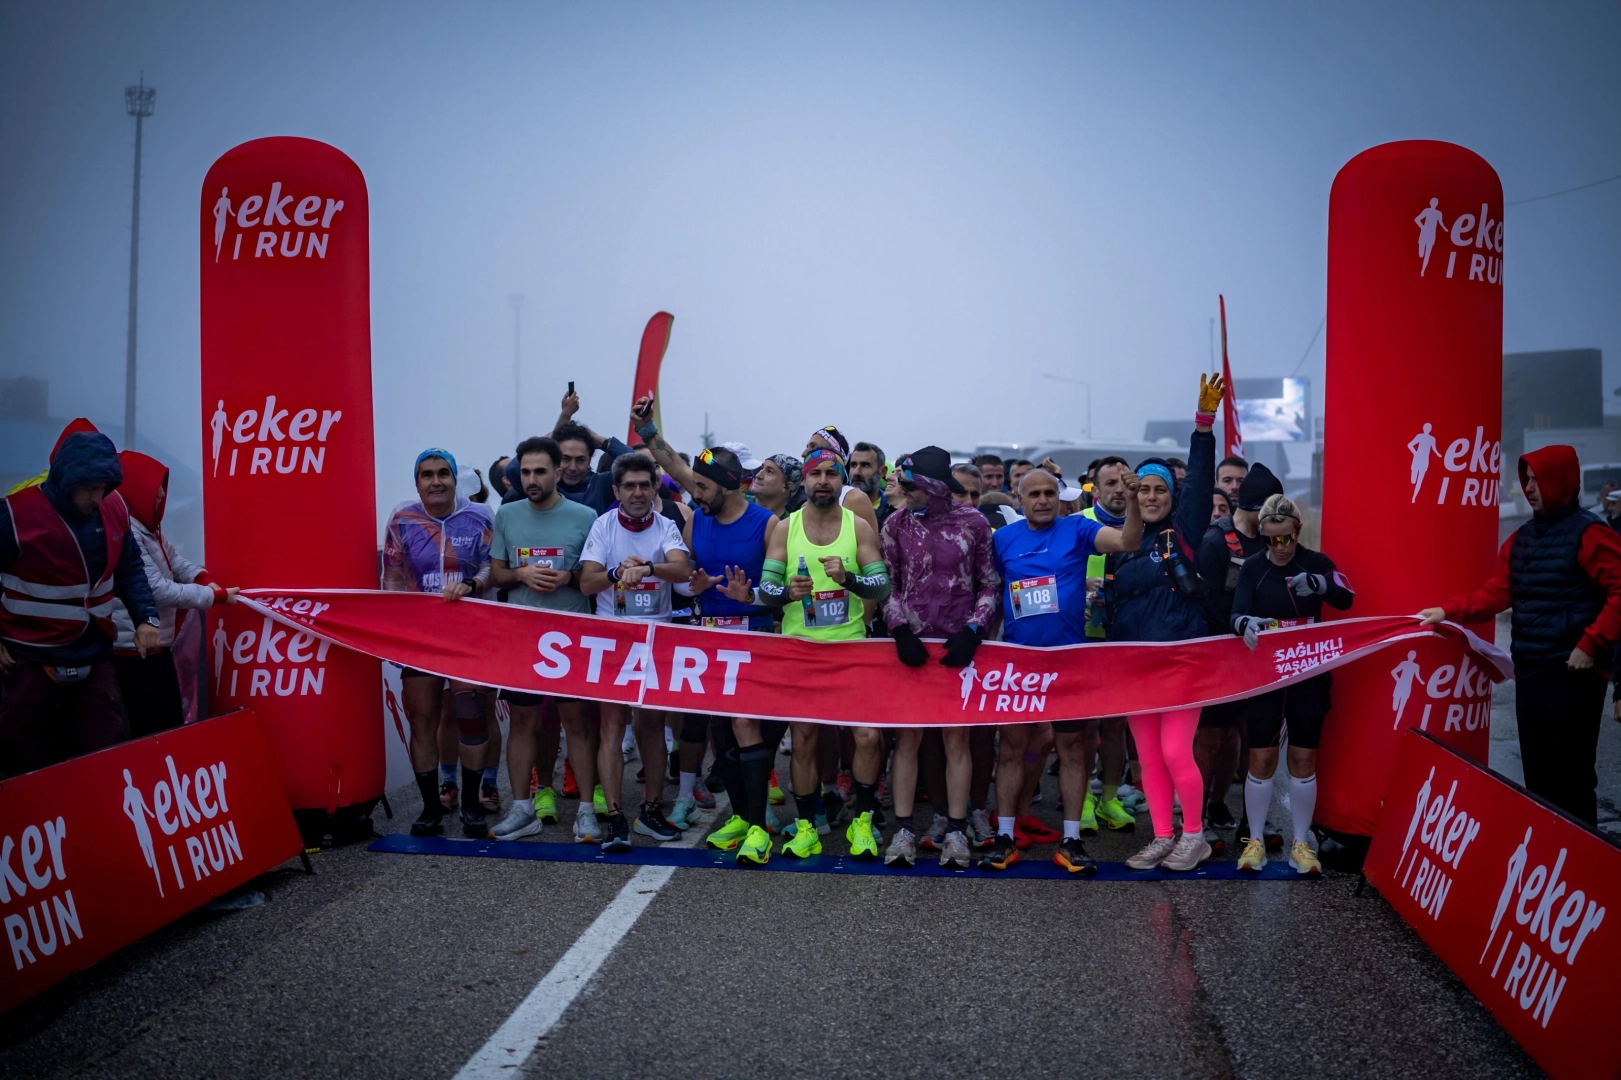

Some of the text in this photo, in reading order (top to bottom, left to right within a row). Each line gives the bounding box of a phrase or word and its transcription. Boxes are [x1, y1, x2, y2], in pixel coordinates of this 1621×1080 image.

[237, 181, 344, 228] eker
[233, 231, 329, 260] I RUN
[1450, 203, 1503, 253] eke
[1446, 251, 1456, 279] I
[232, 395, 342, 444] eker
[229, 446, 326, 476] I RUN
[1444, 425, 1500, 474] eke
[1437, 476, 1450, 505] I
[635, 593, 651, 607] 99
[820, 601, 845, 616] 102
[1025, 589, 1051, 605] 108
[533, 631, 752, 695] START
[1274, 637, 1343, 663] SAĞLIKLI
[230, 667, 326, 697] I RUN
[982, 662, 1058, 692] eker
[1426, 653, 1492, 699] eke
[979, 694, 1046, 712] I RUN
[1420, 700, 1490, 732] I RUN
[154, 755, 229, 835] eker
[1420, 780, 1480, 870] eker
[0, 816, 66, 904] ker
[168, 820, 243, 890] I RUN
[1401, 849, 1453, 921] I RUN
[1515, 848, 1606, 966] eker
[3, 889, 84, 971] RUN
[1491, 930, 1567, 1029] I RUN
